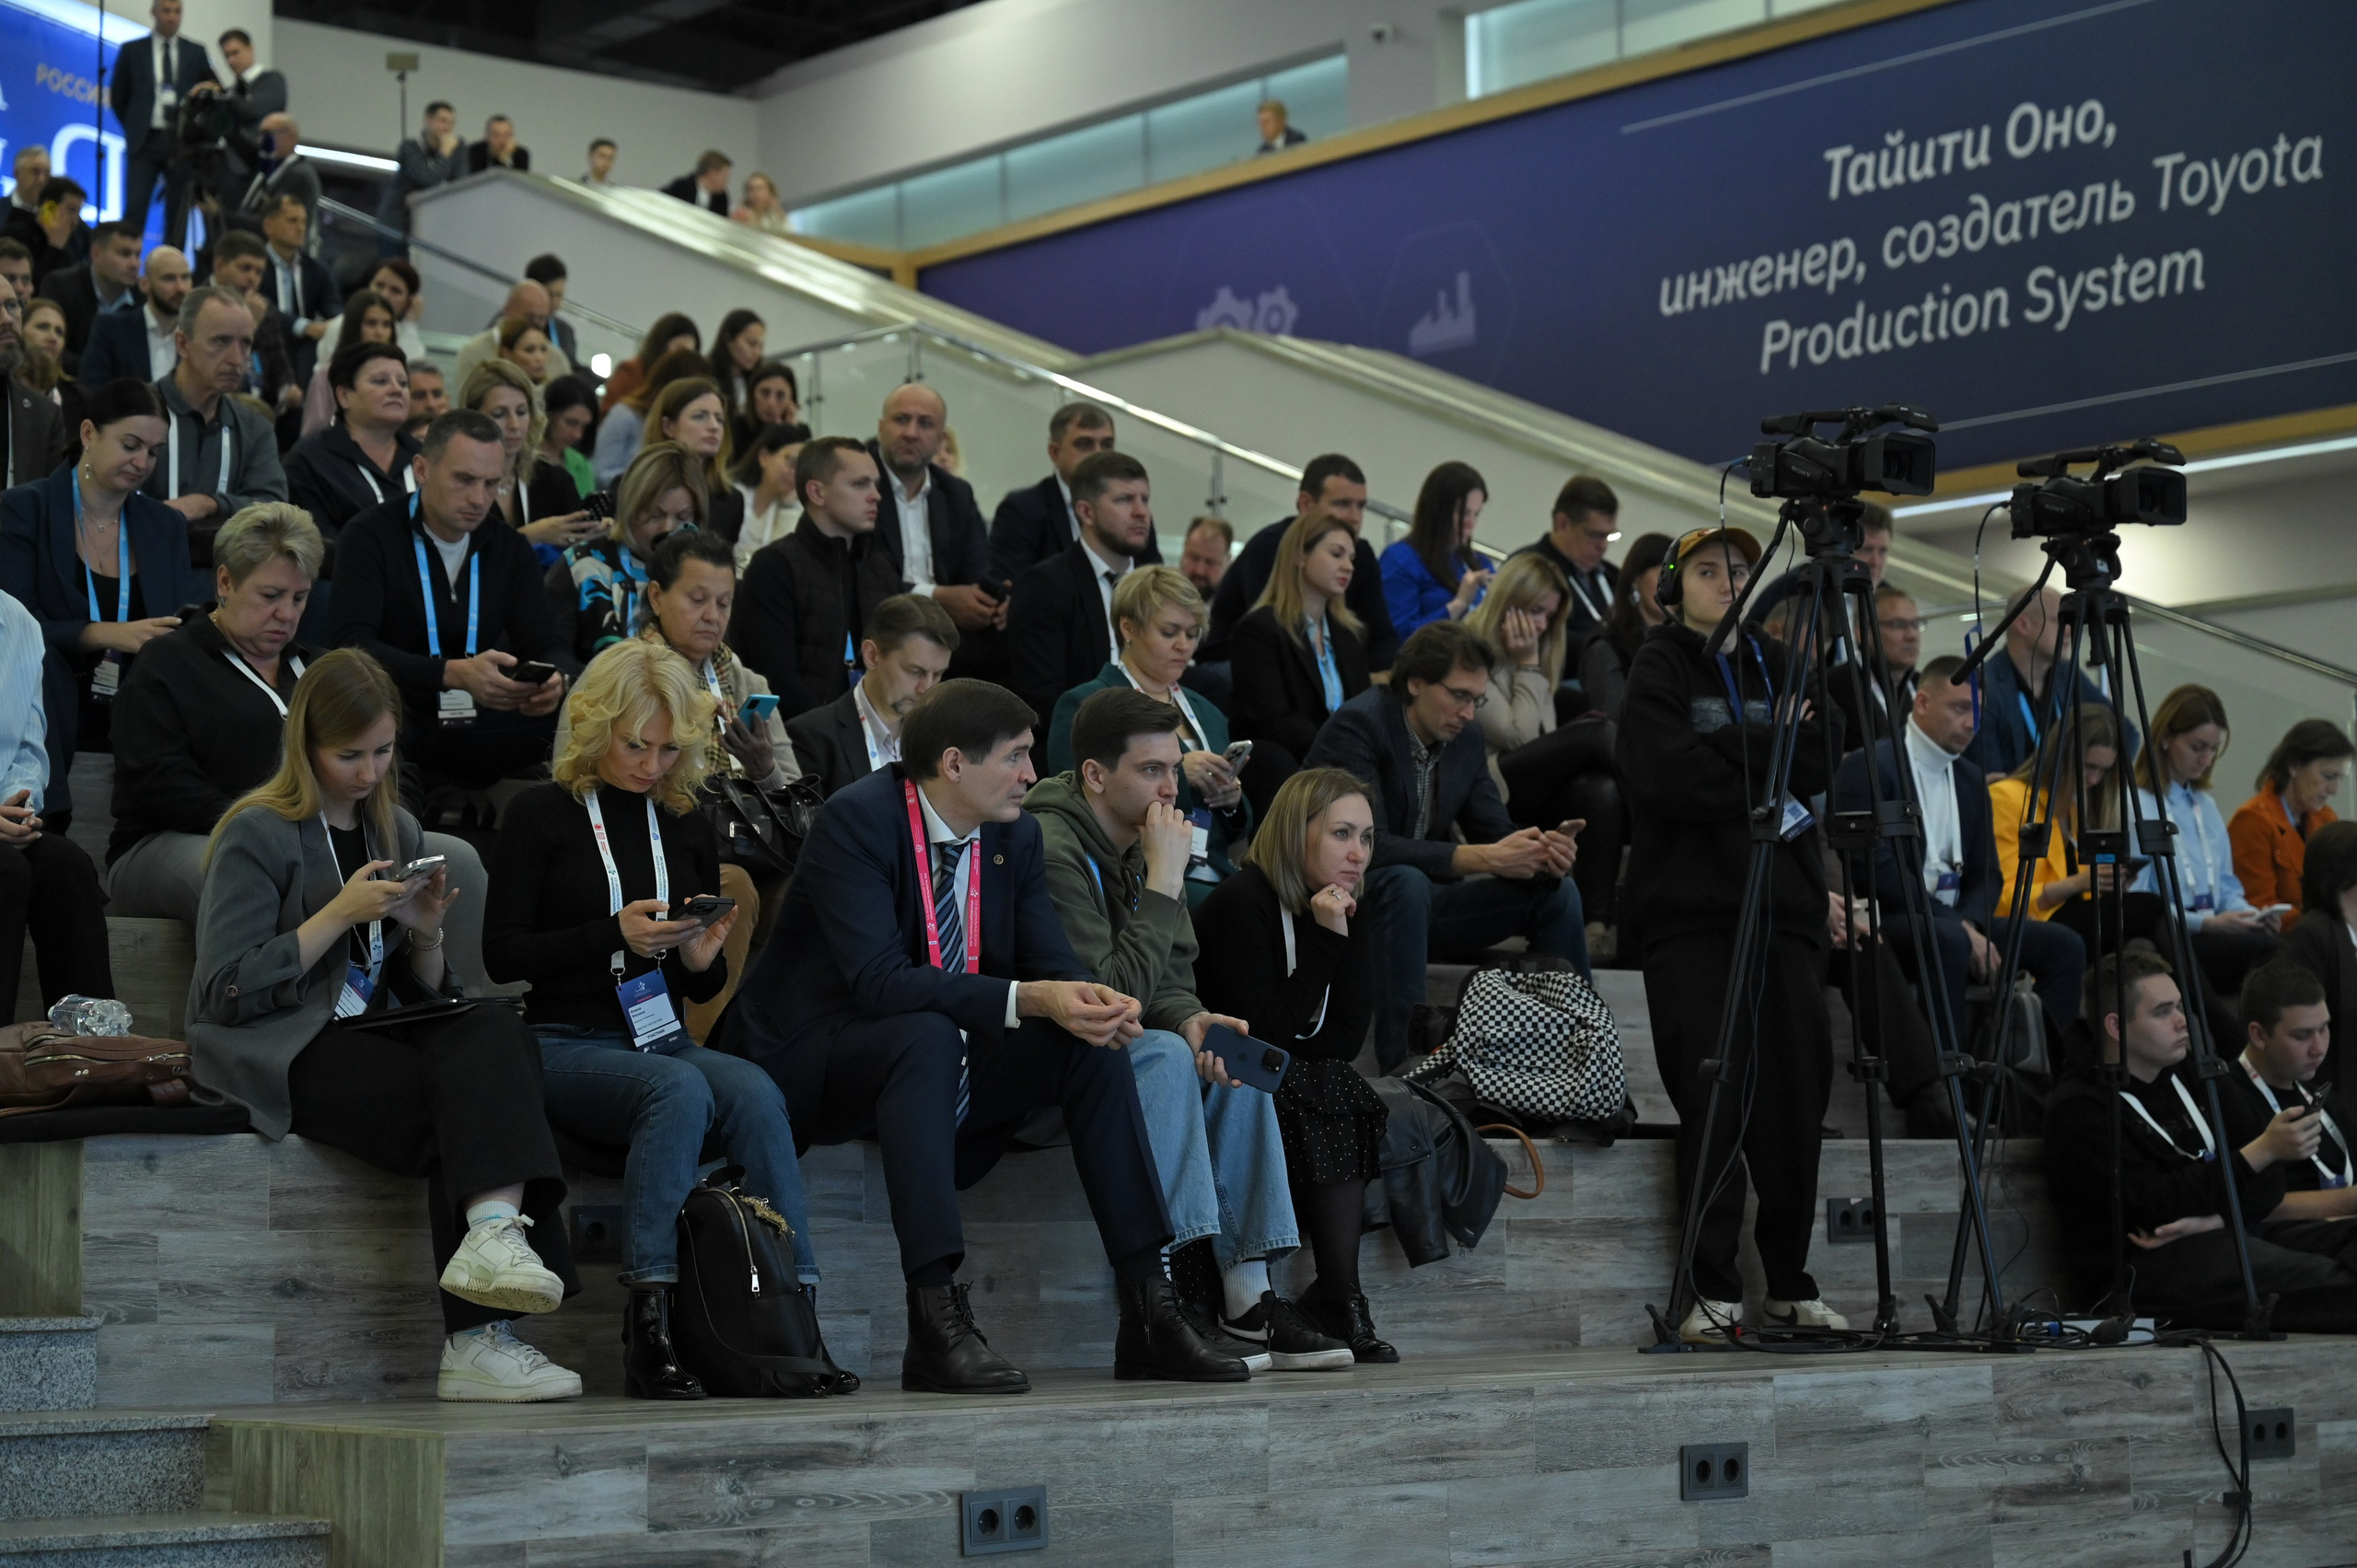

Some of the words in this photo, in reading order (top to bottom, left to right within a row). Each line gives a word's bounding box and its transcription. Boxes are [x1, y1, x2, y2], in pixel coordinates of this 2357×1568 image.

[1824, 125, 1991, 201] Тайити
[2006, 99, 2117, 158] Оно,
[1659, 238, 1866, 317] инженер,
[1882, 180, 2136, 268] создатель
[2152, 134, 2324, 215] Toyota
[1759, 284, 2011, 375] Production
[2024, 248, 2206, 331] System
[1792, 465, 1812, 478] SONY
